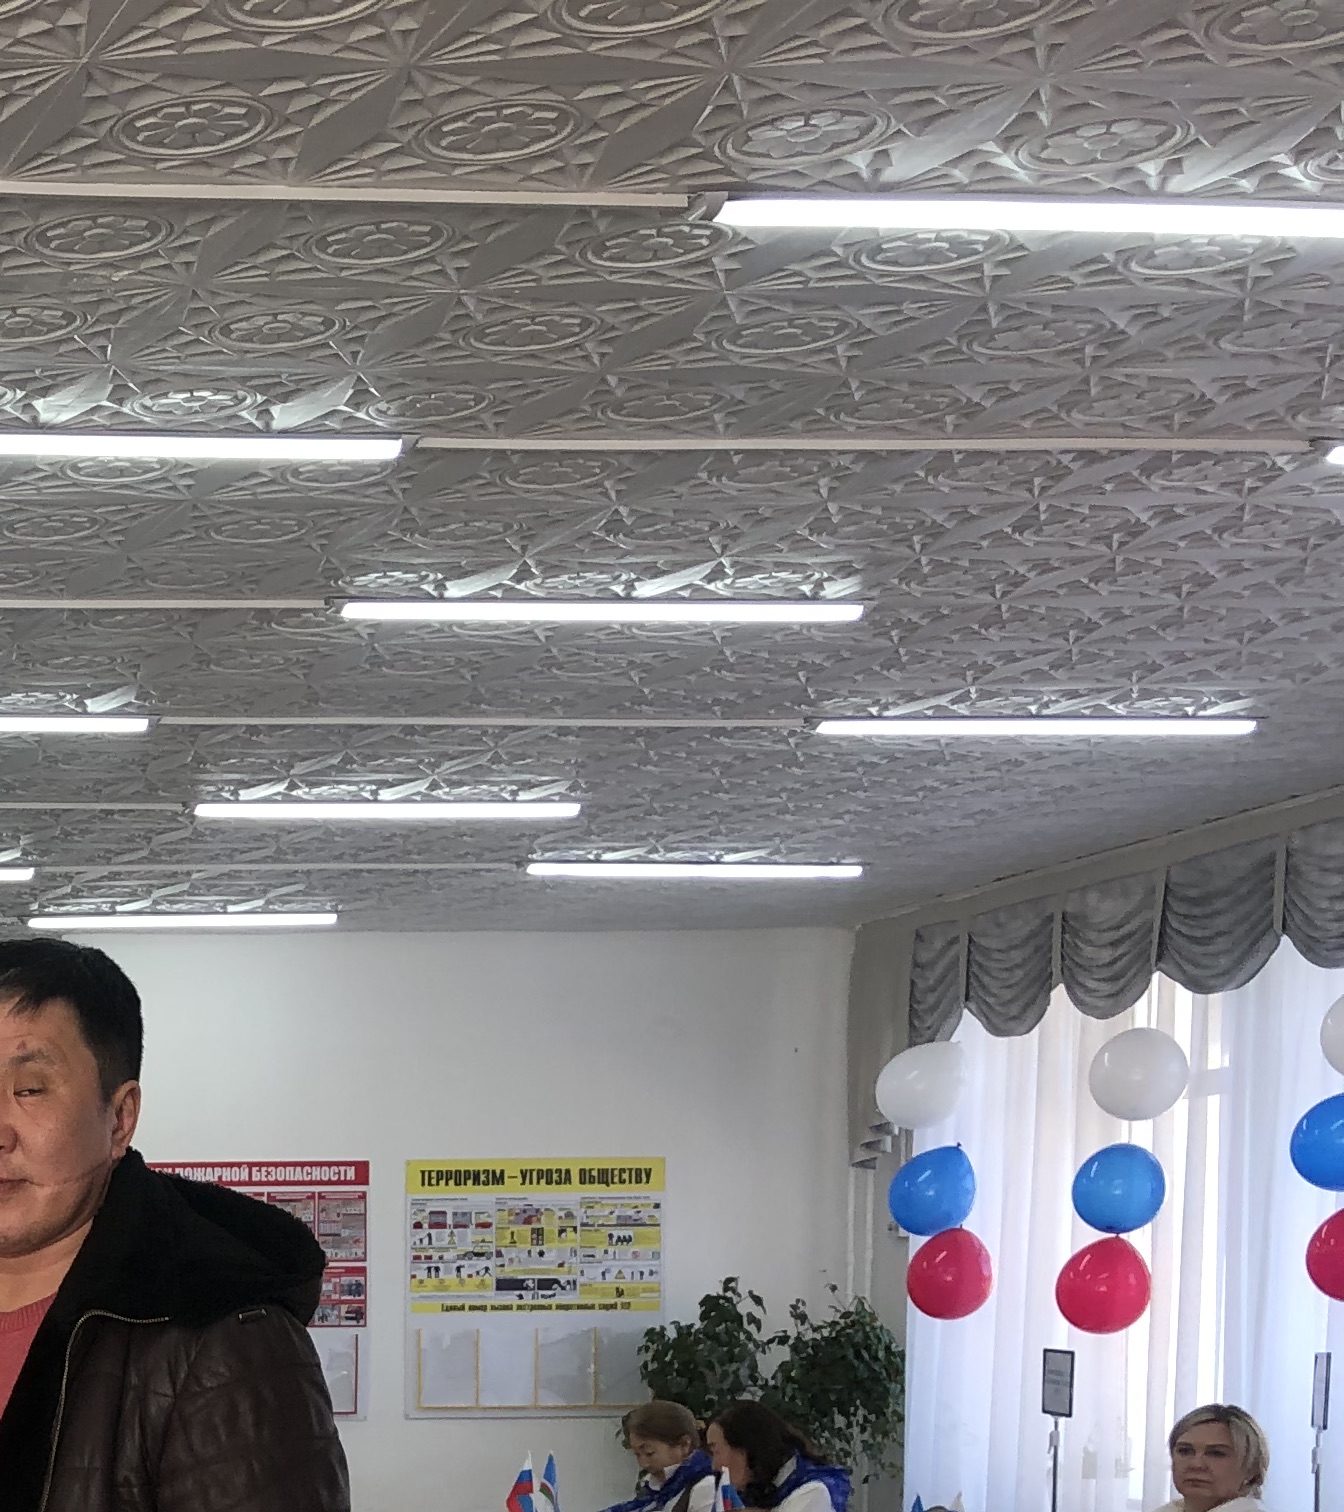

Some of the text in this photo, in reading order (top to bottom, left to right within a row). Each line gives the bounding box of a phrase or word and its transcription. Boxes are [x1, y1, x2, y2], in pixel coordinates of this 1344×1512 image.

[175, 1164, 249, 1182] ПОЖАРНОЙ
[252, 1165, 356, 1182] БЕЗОПАСНОСТИ
[419, 1169, 506, 1187] ТЕРРОРИЗМ
[519, 1168, 573, 1186] УГРОЗА
[578, 1167, 653, 1187] ОБЩЕСТВУ
